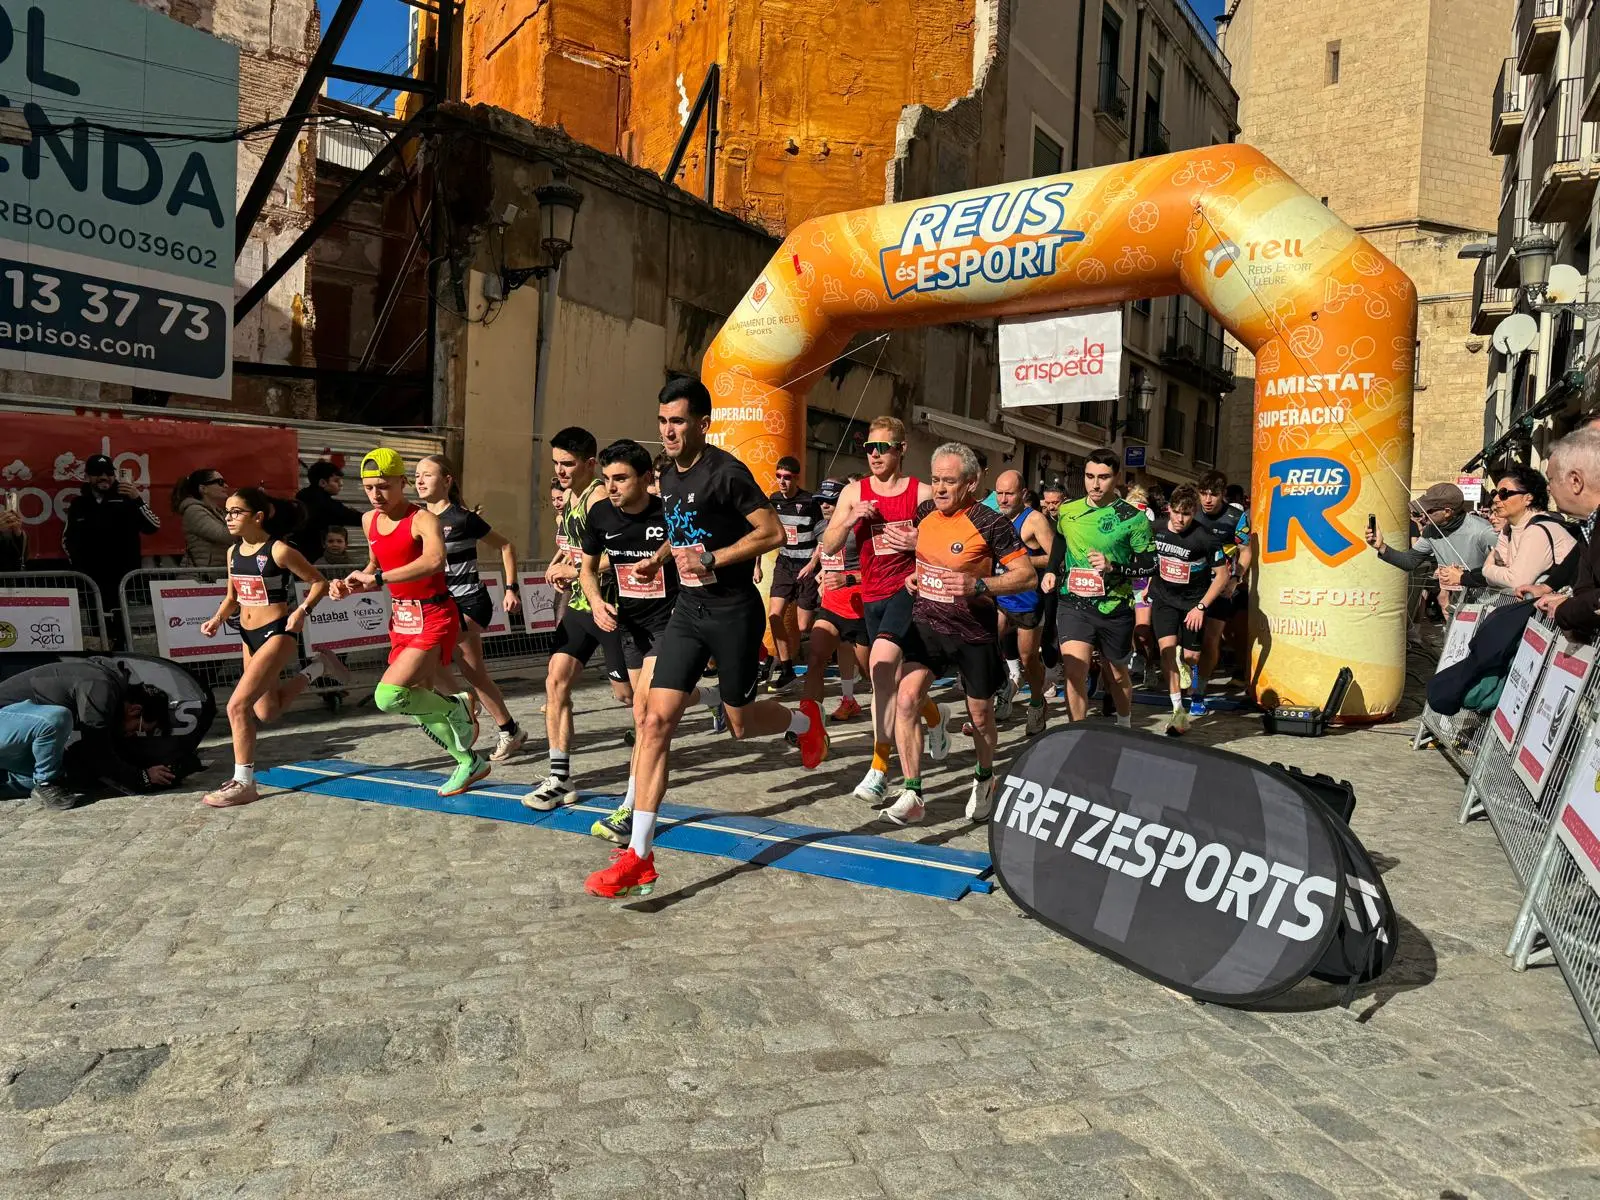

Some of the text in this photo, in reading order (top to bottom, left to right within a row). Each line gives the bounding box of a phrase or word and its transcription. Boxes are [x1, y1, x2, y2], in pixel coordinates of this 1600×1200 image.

[0, 95, 225, 229] NDA
[899, 182, 1073, 257] REUS
[917, 236, 1062, 290] ESPORT
[81, 283, 139, 327] 37
[158, 299, 209, 341] 73
[766, 317, 777, 326] DE
[780, 315, 800, 324] REUS
[745, 328, 773, 336] ESPORTS
[1083, 336, 1105, 359] la
[1265, 373, 1376, 397] AMISTAT
[1259, 405, 1346, 429] SUPERACIÓ
[1286, 468, 1344, 486] REUS
[1289, 485, 1343, 496] ESPORT
[1155, 540, 1191, 557] CTOWAVE
[921, 575, 943, 589] 240
[1075, 577, 1095, 587] 396
[1279, 588, 1382, 613] ESFORÇ
[310, 611, 349, 622] batabat
[1269, 617, 1327, 641] NFIANÇA
[993, 774, 1337, 942] TRETZESPORTS
